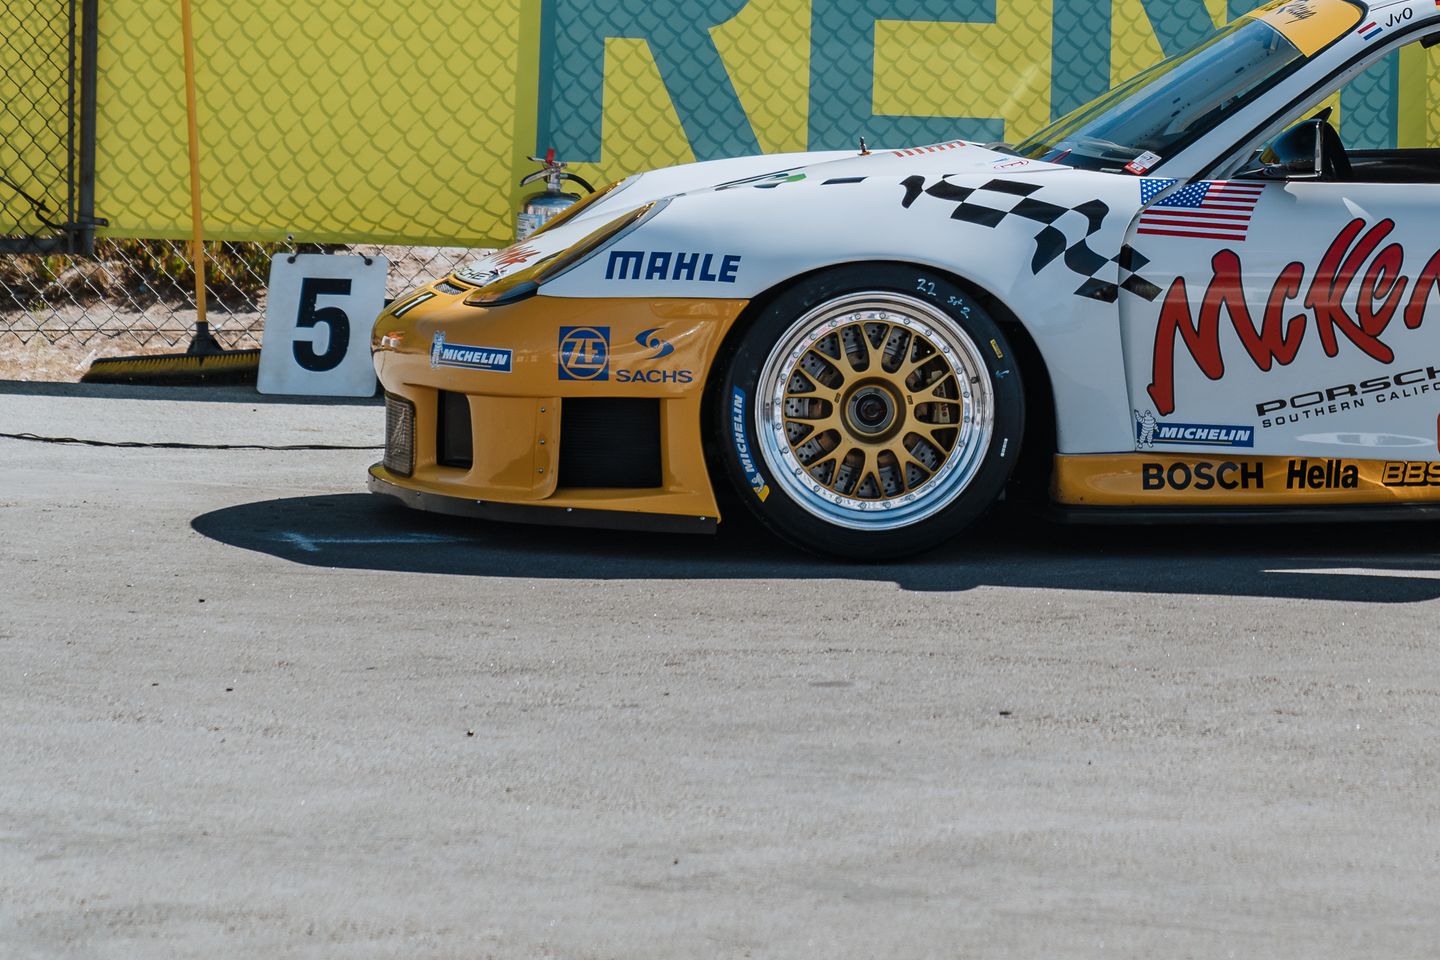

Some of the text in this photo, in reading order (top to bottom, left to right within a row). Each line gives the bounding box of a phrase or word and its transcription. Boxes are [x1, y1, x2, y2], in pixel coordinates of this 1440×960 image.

[1385, 7, 1413, 27] JvO
[605, 251, 742, 283] MAHLE
[916, 278, 937, 297] 22
[960, 306, 972, 319] 2
[292, 277, 352, 372] 5
[442, 347, 508, 366] MICHELIN
[563, 337, 606, 369] ZF
[616, 369, 693, 384] SACHS
[1262, 398, 1365, 428] SOUTHERN
[733, 394, 755, 473] MICHELIN
[1159, 426, 1251, 442] MICHELIN
[1142, 461, 1266, 490] BOSCH
[1286, 460, 1359, 489] Hella
